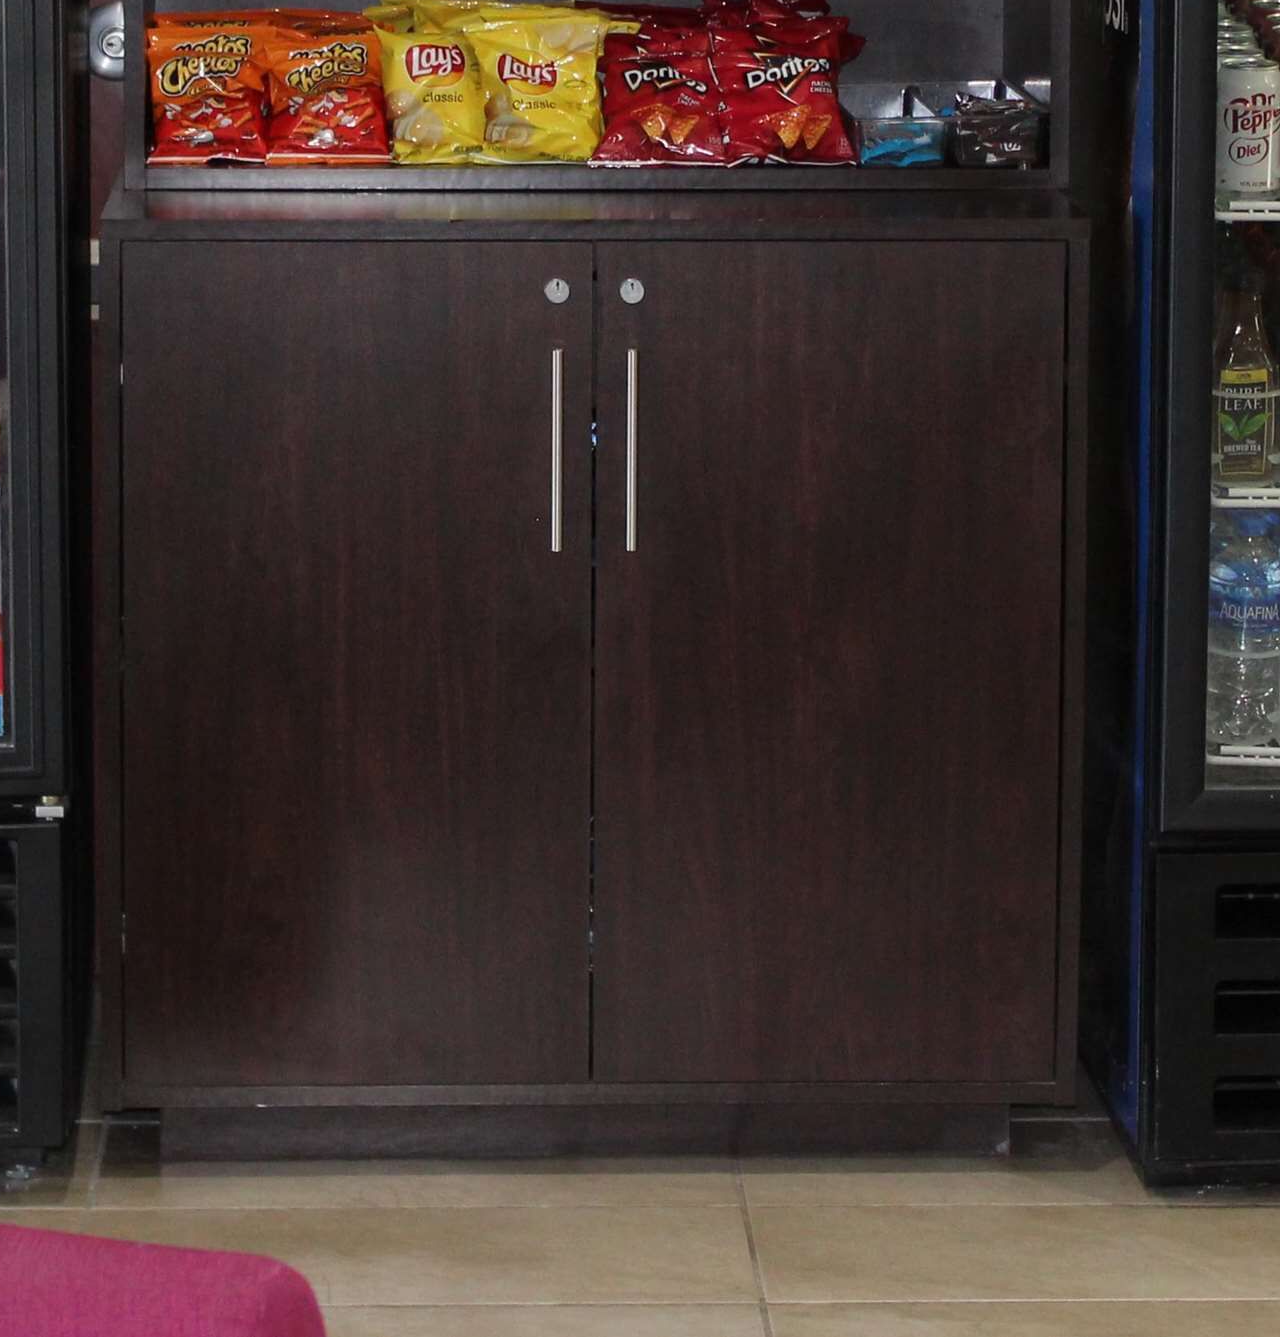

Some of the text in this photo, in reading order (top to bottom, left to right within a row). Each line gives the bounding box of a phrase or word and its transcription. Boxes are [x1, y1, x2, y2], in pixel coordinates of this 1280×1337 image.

[412, 45, 462, 77] Lay's
[502, 55, 555, 84] Lay's
[747, 57, 830, 88] Doritos
[161, 57, 240, 95] Cheetos
[1236, 143, 1261, 158] Diet
[1224, 399, 1262, 411] LEAF
[1220, 602, 1280, 622] AQUAFINA
